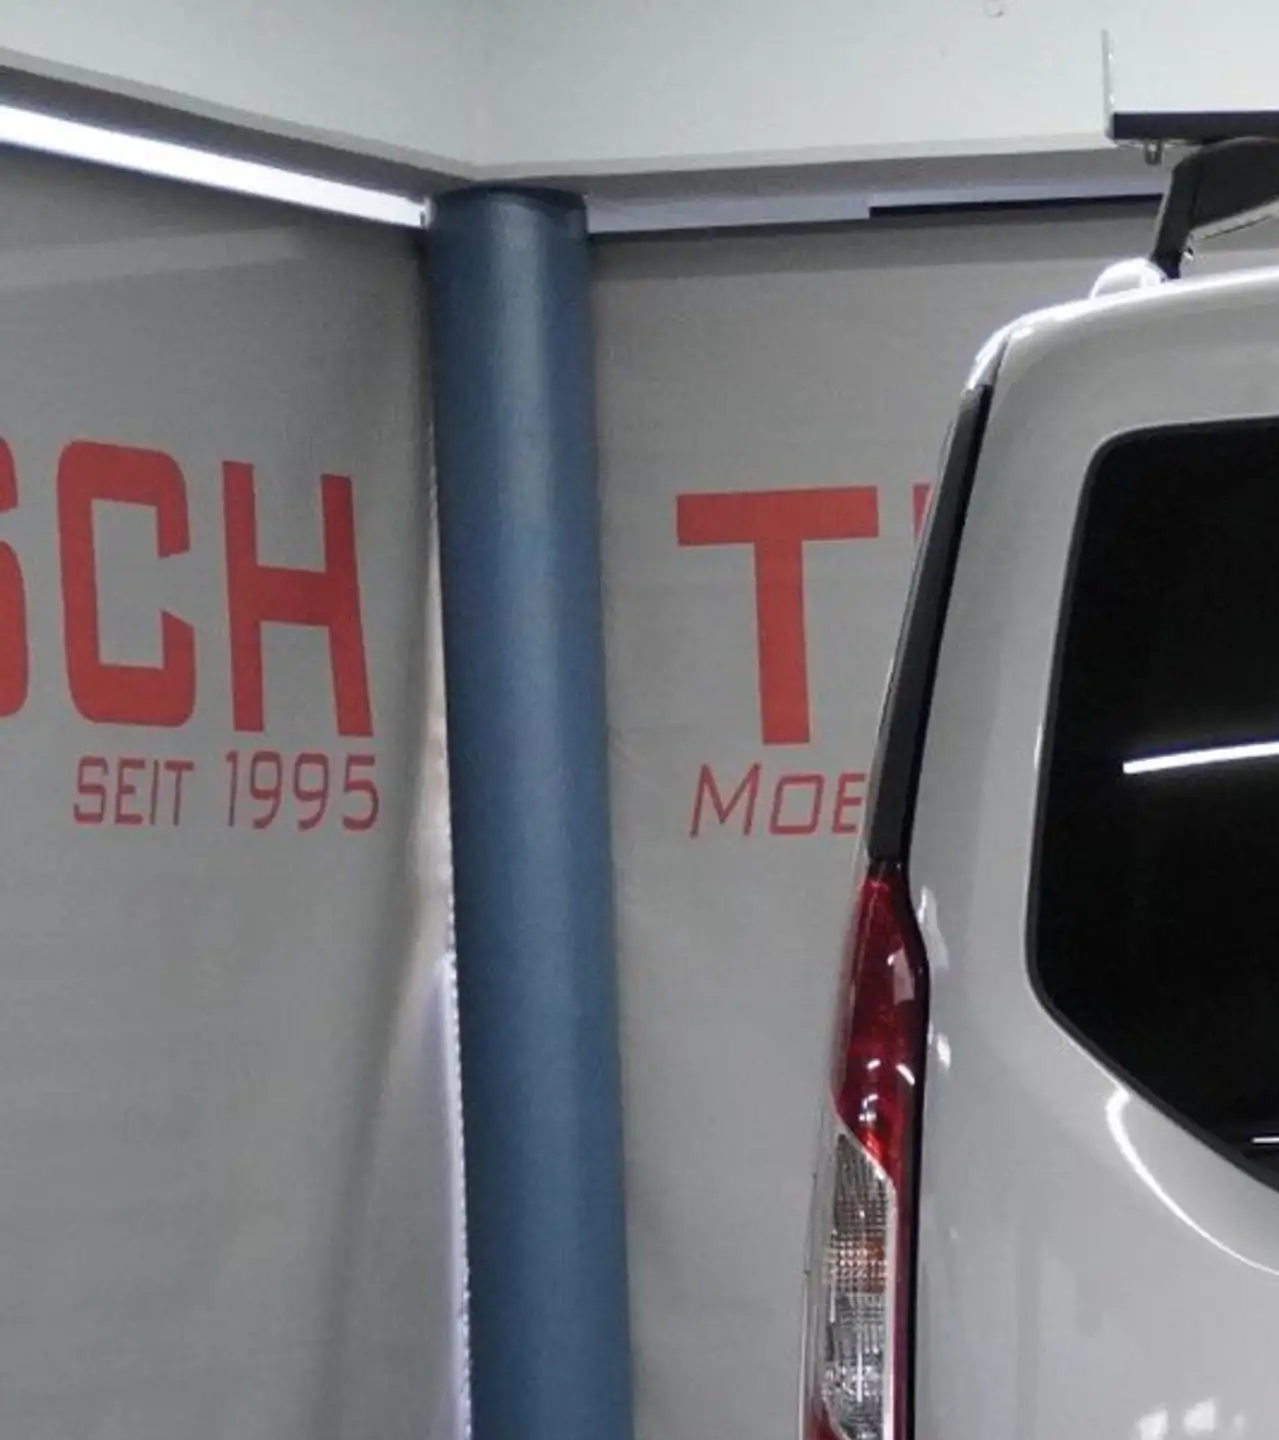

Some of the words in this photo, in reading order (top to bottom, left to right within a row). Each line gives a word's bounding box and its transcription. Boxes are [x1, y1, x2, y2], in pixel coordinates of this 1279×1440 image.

[0, 436, 374, 738] CH
[73, 756, 196, 827] SEIT
[225, 750, 380, 832] 1995
